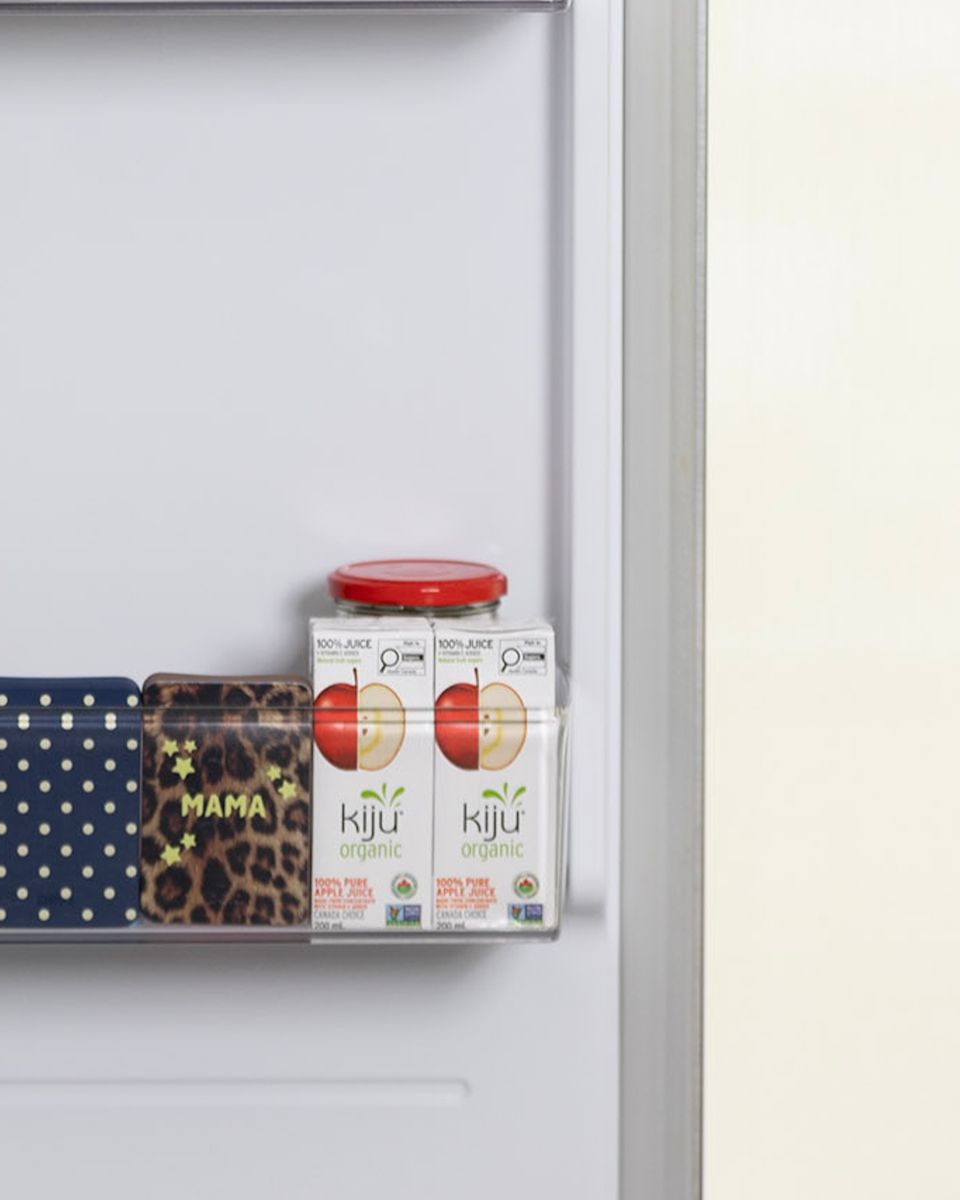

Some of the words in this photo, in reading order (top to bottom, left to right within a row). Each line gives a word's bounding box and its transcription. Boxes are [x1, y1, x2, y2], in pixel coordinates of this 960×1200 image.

[316, 639, 342, 649] 100%
[344, 639, 372, 649] JUICE
[438, 639, 464, 649] 100%
[465, 639, 493, 649] JUICE
[181, 793, 267, 818] MAMA
[341, 803, 398, 842] kiju
[463, 803, 520, 842] kiju
[340, 840, 402, 862] organic
[461, 840, 524, 862] organic
[314, 878, 342, 886] 100%
[344, 878, 368, 886] PURE
[436, 878, 464, 886] 100%
[465, 878, 489, 886] PURE
[314, 888, 342, 897] APPLE
[347, 888, 374, 897] JUICE
[436, 888, 464, 897] APPLE
[470, 888, 496, 897] JUICE
[314, 922, 330, 930] 200
[436, 922, 452, 930] 200
